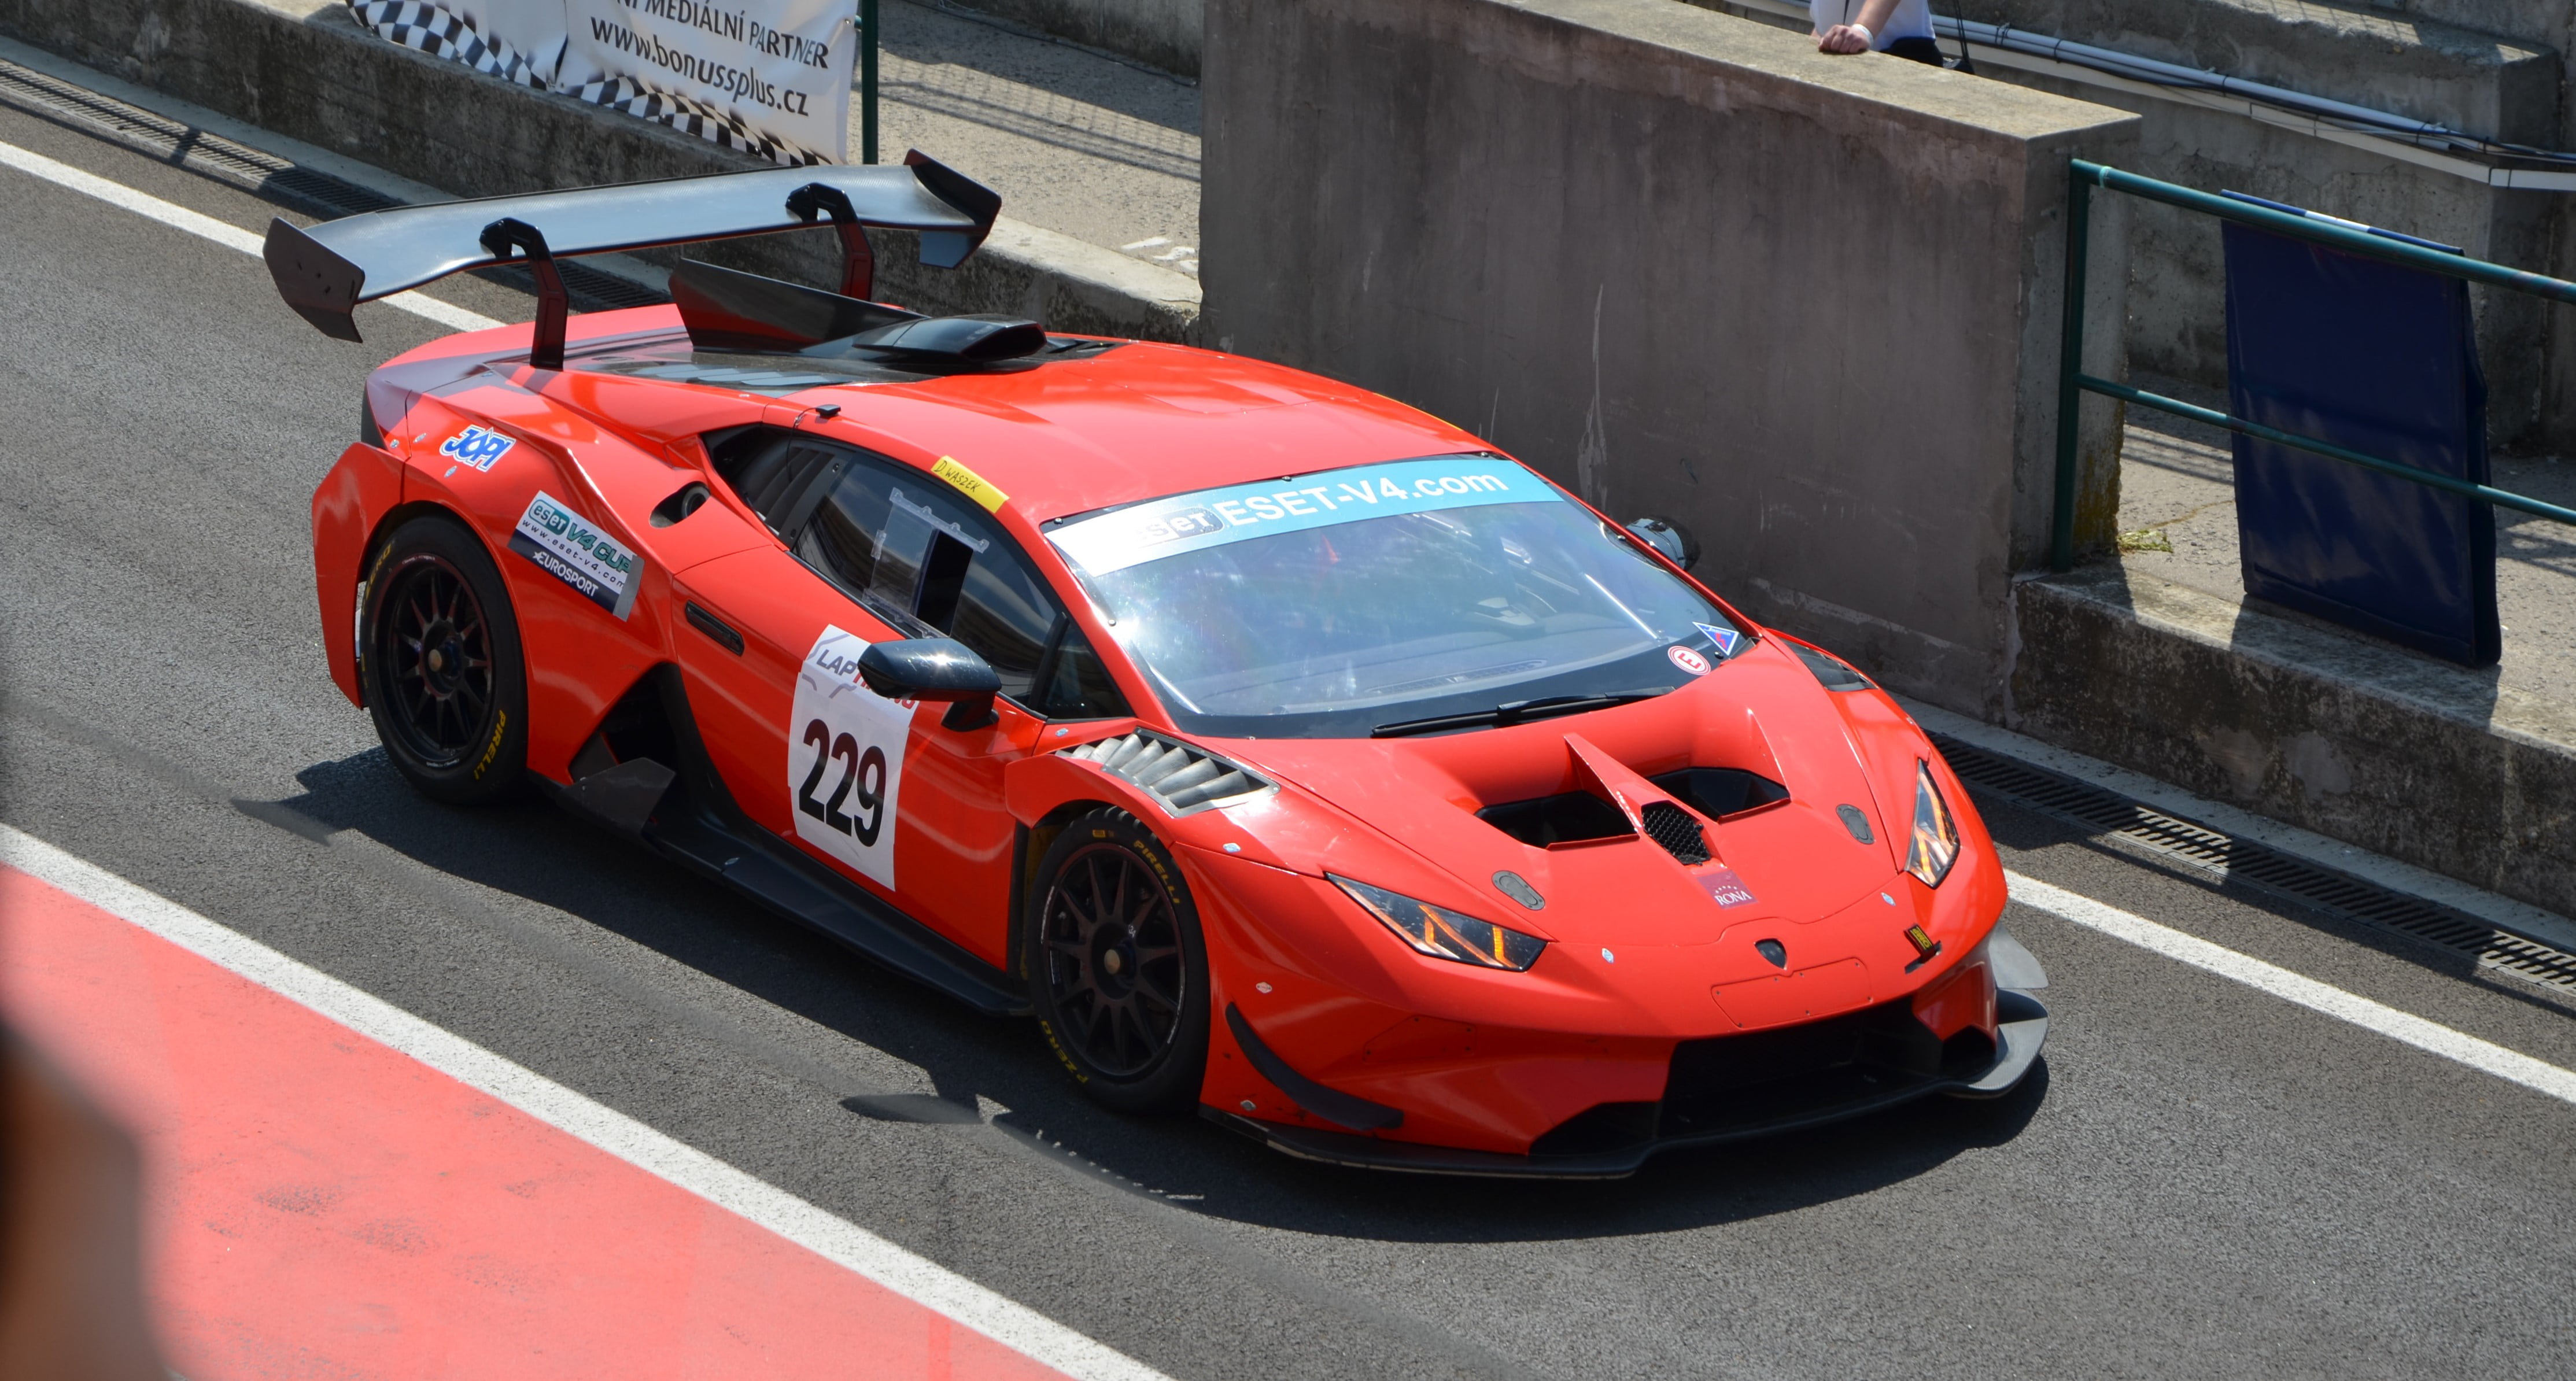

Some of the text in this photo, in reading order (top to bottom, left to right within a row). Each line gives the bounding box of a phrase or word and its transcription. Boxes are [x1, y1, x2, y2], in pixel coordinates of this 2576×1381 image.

[591, 17, 809, 116] www.bonussplus.cz
[749, 21, 829, 69] PARTNER
[1212, 474, 1509, 526] ESET-V4.com
[537, 551, 599, 597] EUROSPORT
[566, 522, 598, 552] V4
[592, 541, 632, 574] CUP
[473, 708, 507, 782] PIRELLI
[799, 719, 887, 847] 229
[1133, 839, 1181, 904] PIRELLI
[1714, 889, 1753, 906] RONA
